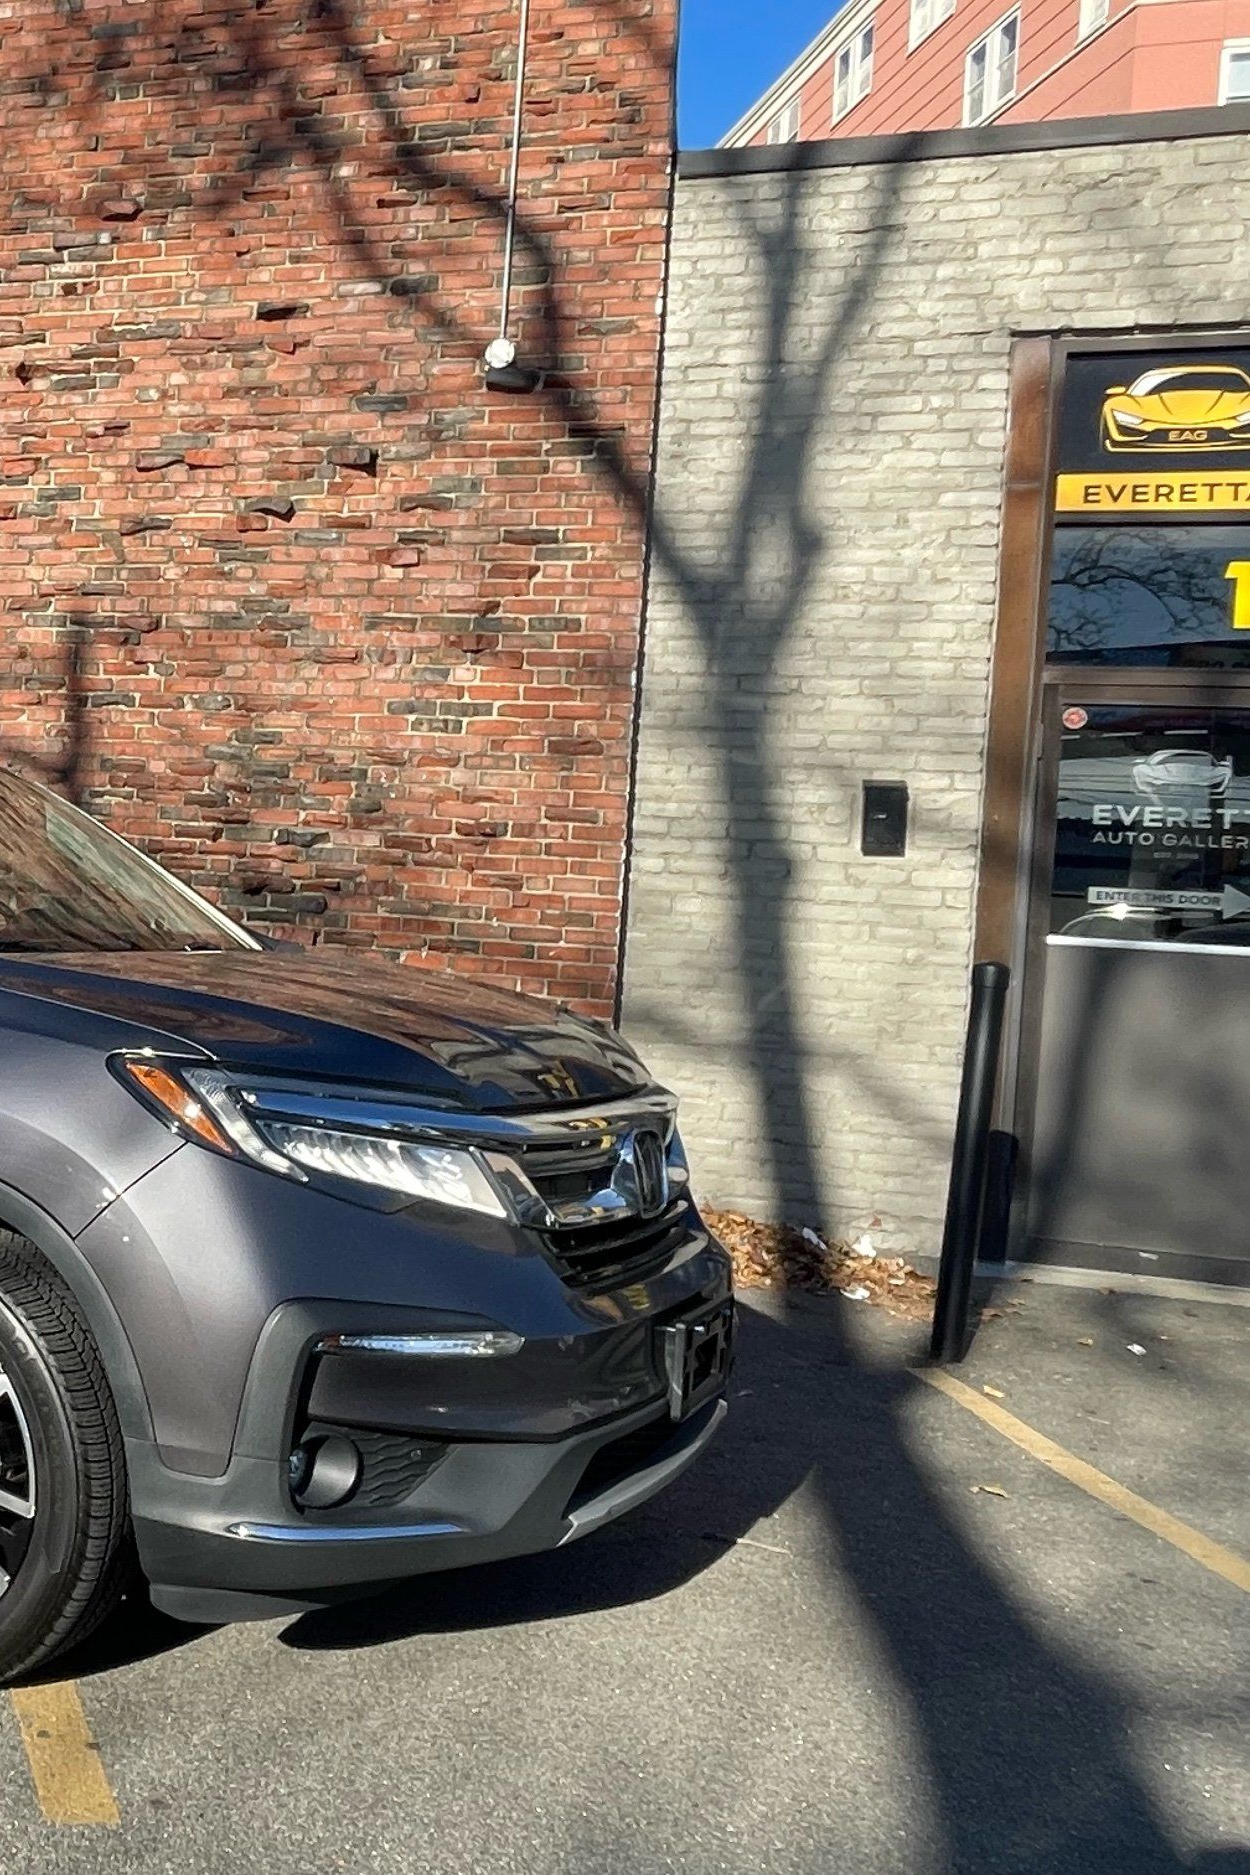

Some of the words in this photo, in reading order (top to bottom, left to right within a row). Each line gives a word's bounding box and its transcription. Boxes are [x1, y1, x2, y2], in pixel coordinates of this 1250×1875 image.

[1167, 430, 1208, 441] EAG
[1092, 831, 1155, 846] AUTO
[1162, 833, 1249, 849] GALLER
[1096, 890, 1142, 902] ENTER
[1144, 891, 1175, 904] THIS
[1179, 894, 1221, 906] DOOR
